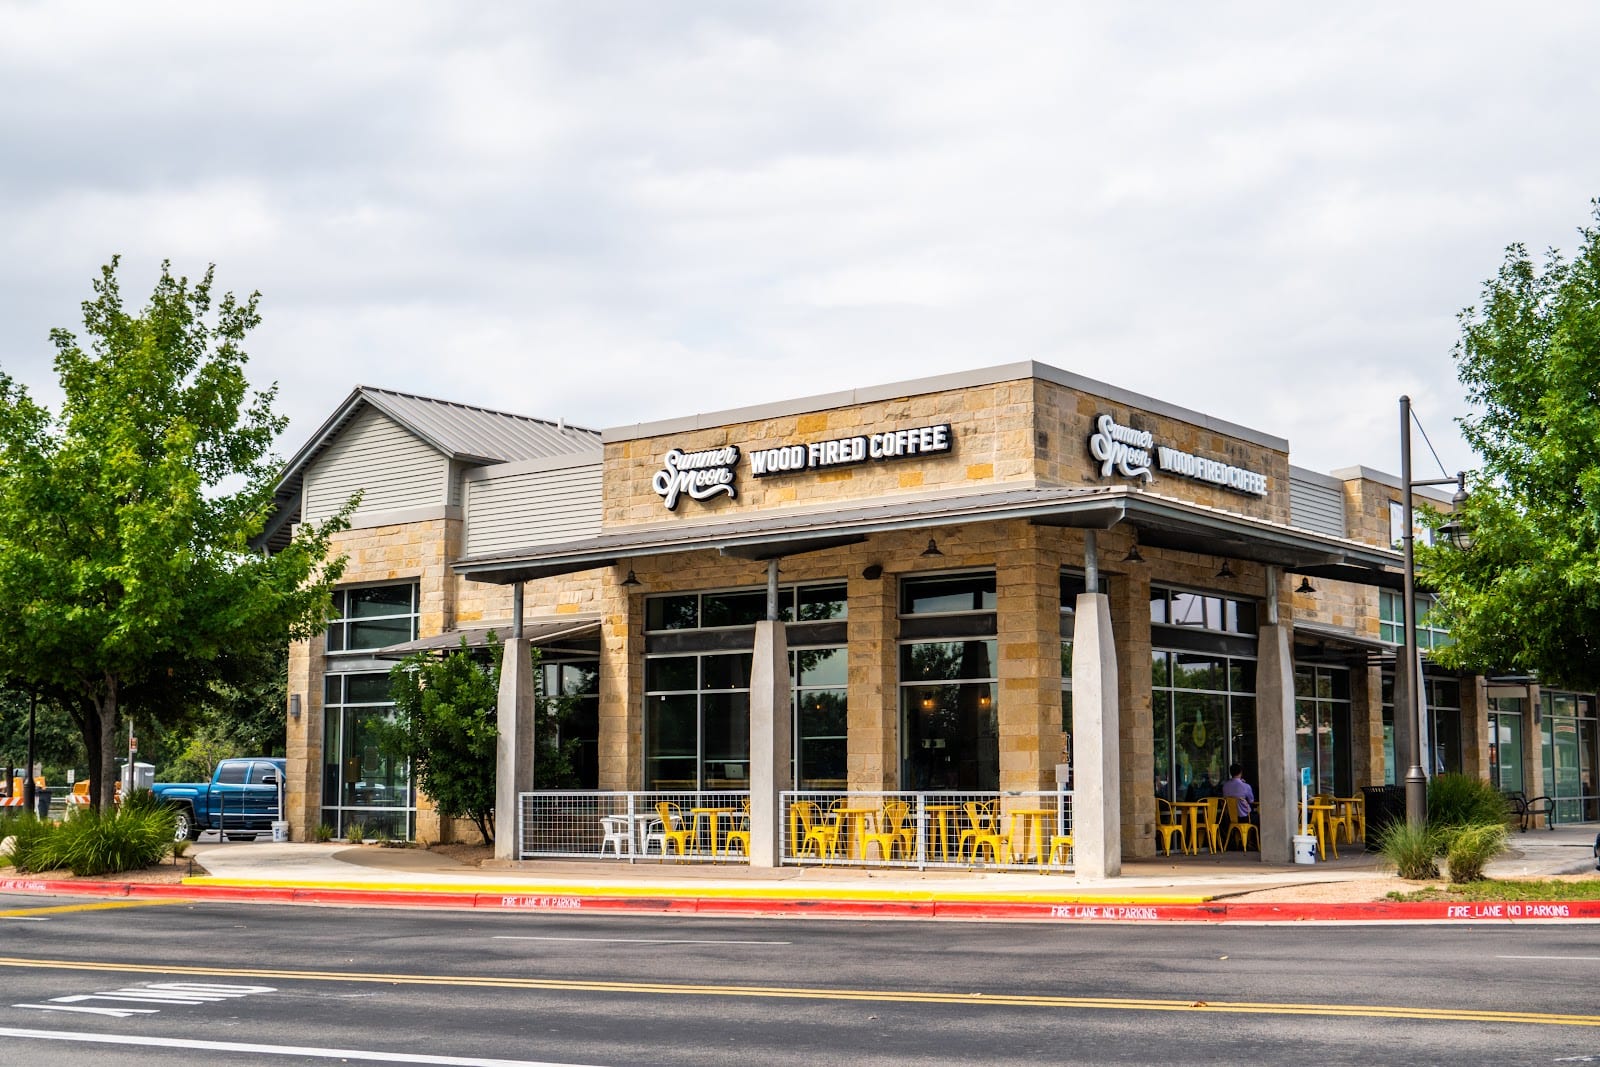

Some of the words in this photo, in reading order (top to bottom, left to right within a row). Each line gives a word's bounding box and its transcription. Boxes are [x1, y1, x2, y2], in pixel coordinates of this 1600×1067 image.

[750, 445, 806, 475] WOOD
[808, 437, 867, 467] FIRED
[869, 425, 948, 458] COFFEE
[1102, 441, 1153, 482] Moon
[664, 468, 734, 508] Moon
[1158, 447, 1194, 476] WOOD
[1193, 457, 1228, 485] FIRED
[1227, 466, 1268, 496] COFFEE
[520, 896, 537, 907] LANE
[552, 897, 581, 909] PARKING
[1051, 906, 1071, 918] FIRE
[1075, 906, 1099, 918] LANE
[1102, 907, 1115, 918] NO
[1119, 908, 1157, 919] PARKING
[1448, 905, 1471, 917] FIRE
[1475, 905, 1502, 917] LANE
[1507, 905, 1522, 916] NO
[1525, 905, 1569, 916] PARKING
